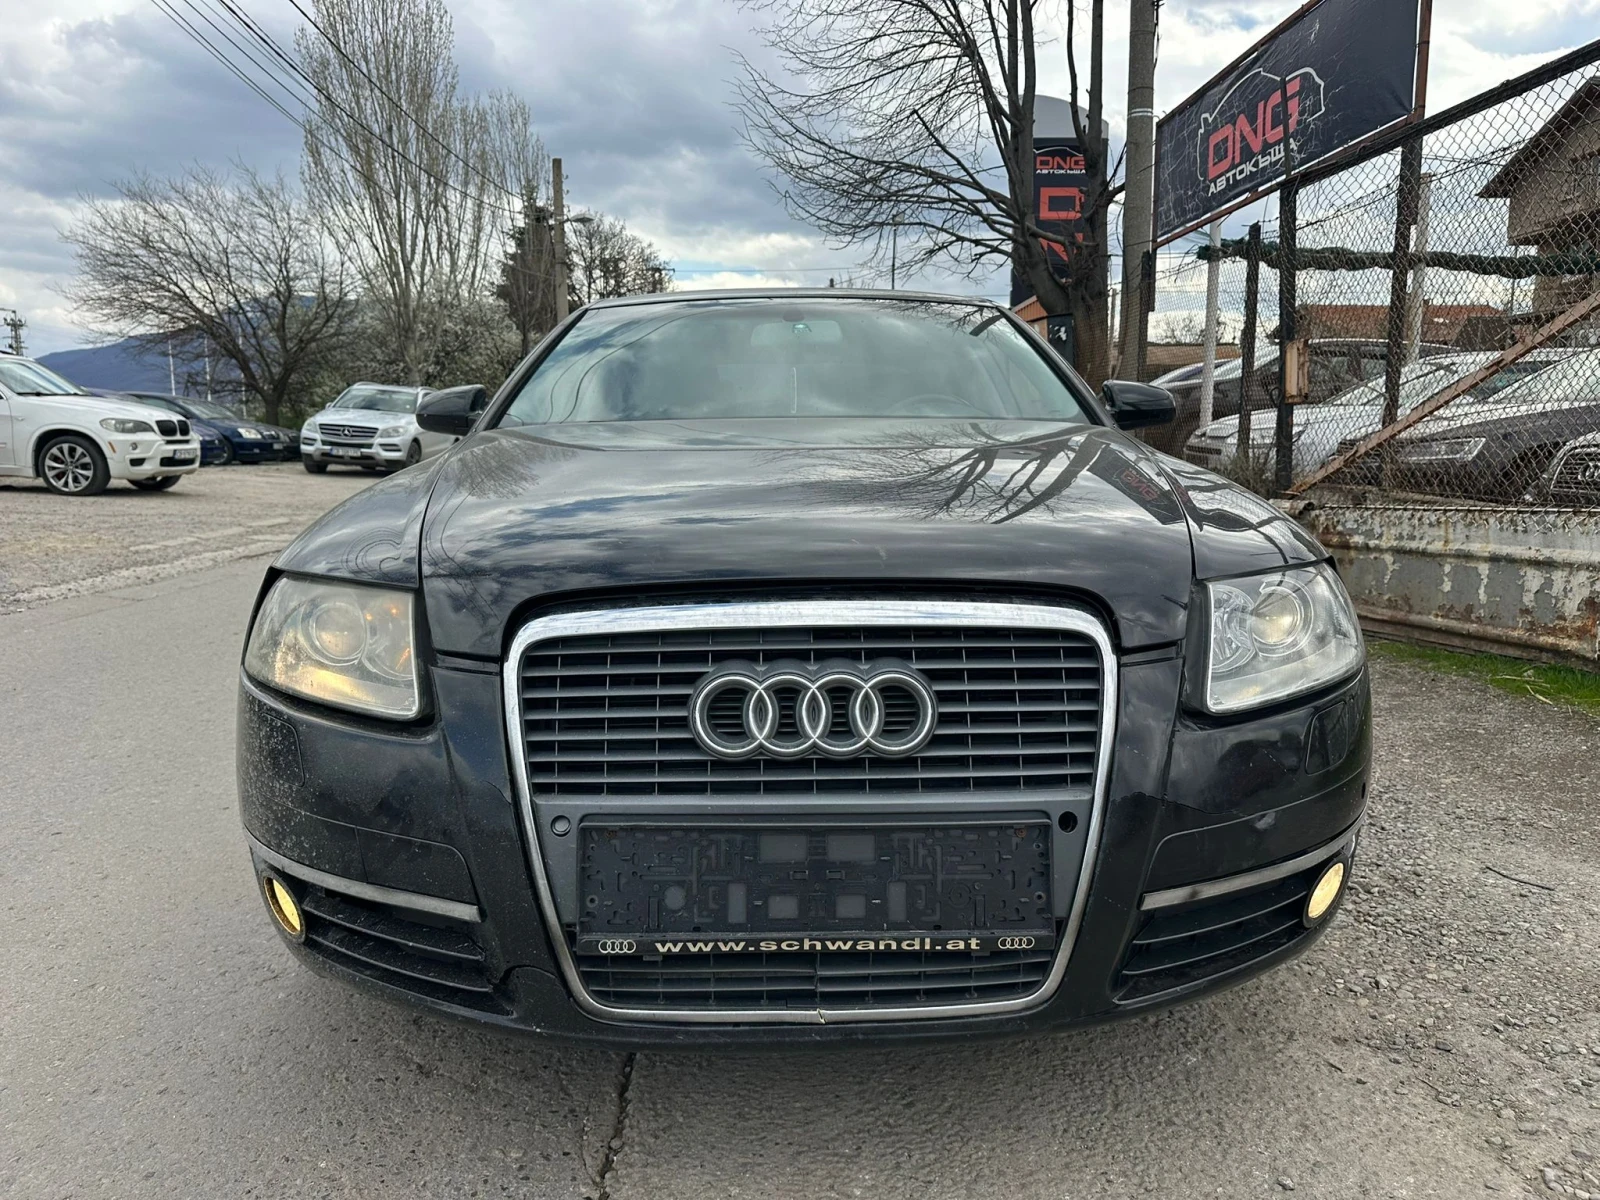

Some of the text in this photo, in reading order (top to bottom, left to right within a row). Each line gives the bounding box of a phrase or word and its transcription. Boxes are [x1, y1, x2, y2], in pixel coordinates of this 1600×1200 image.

[1208, 76, 1301, 180] DNG
[1036, 156, 1085, 169] DNG
[655, 938, 980, 952] www.schwandl.at
